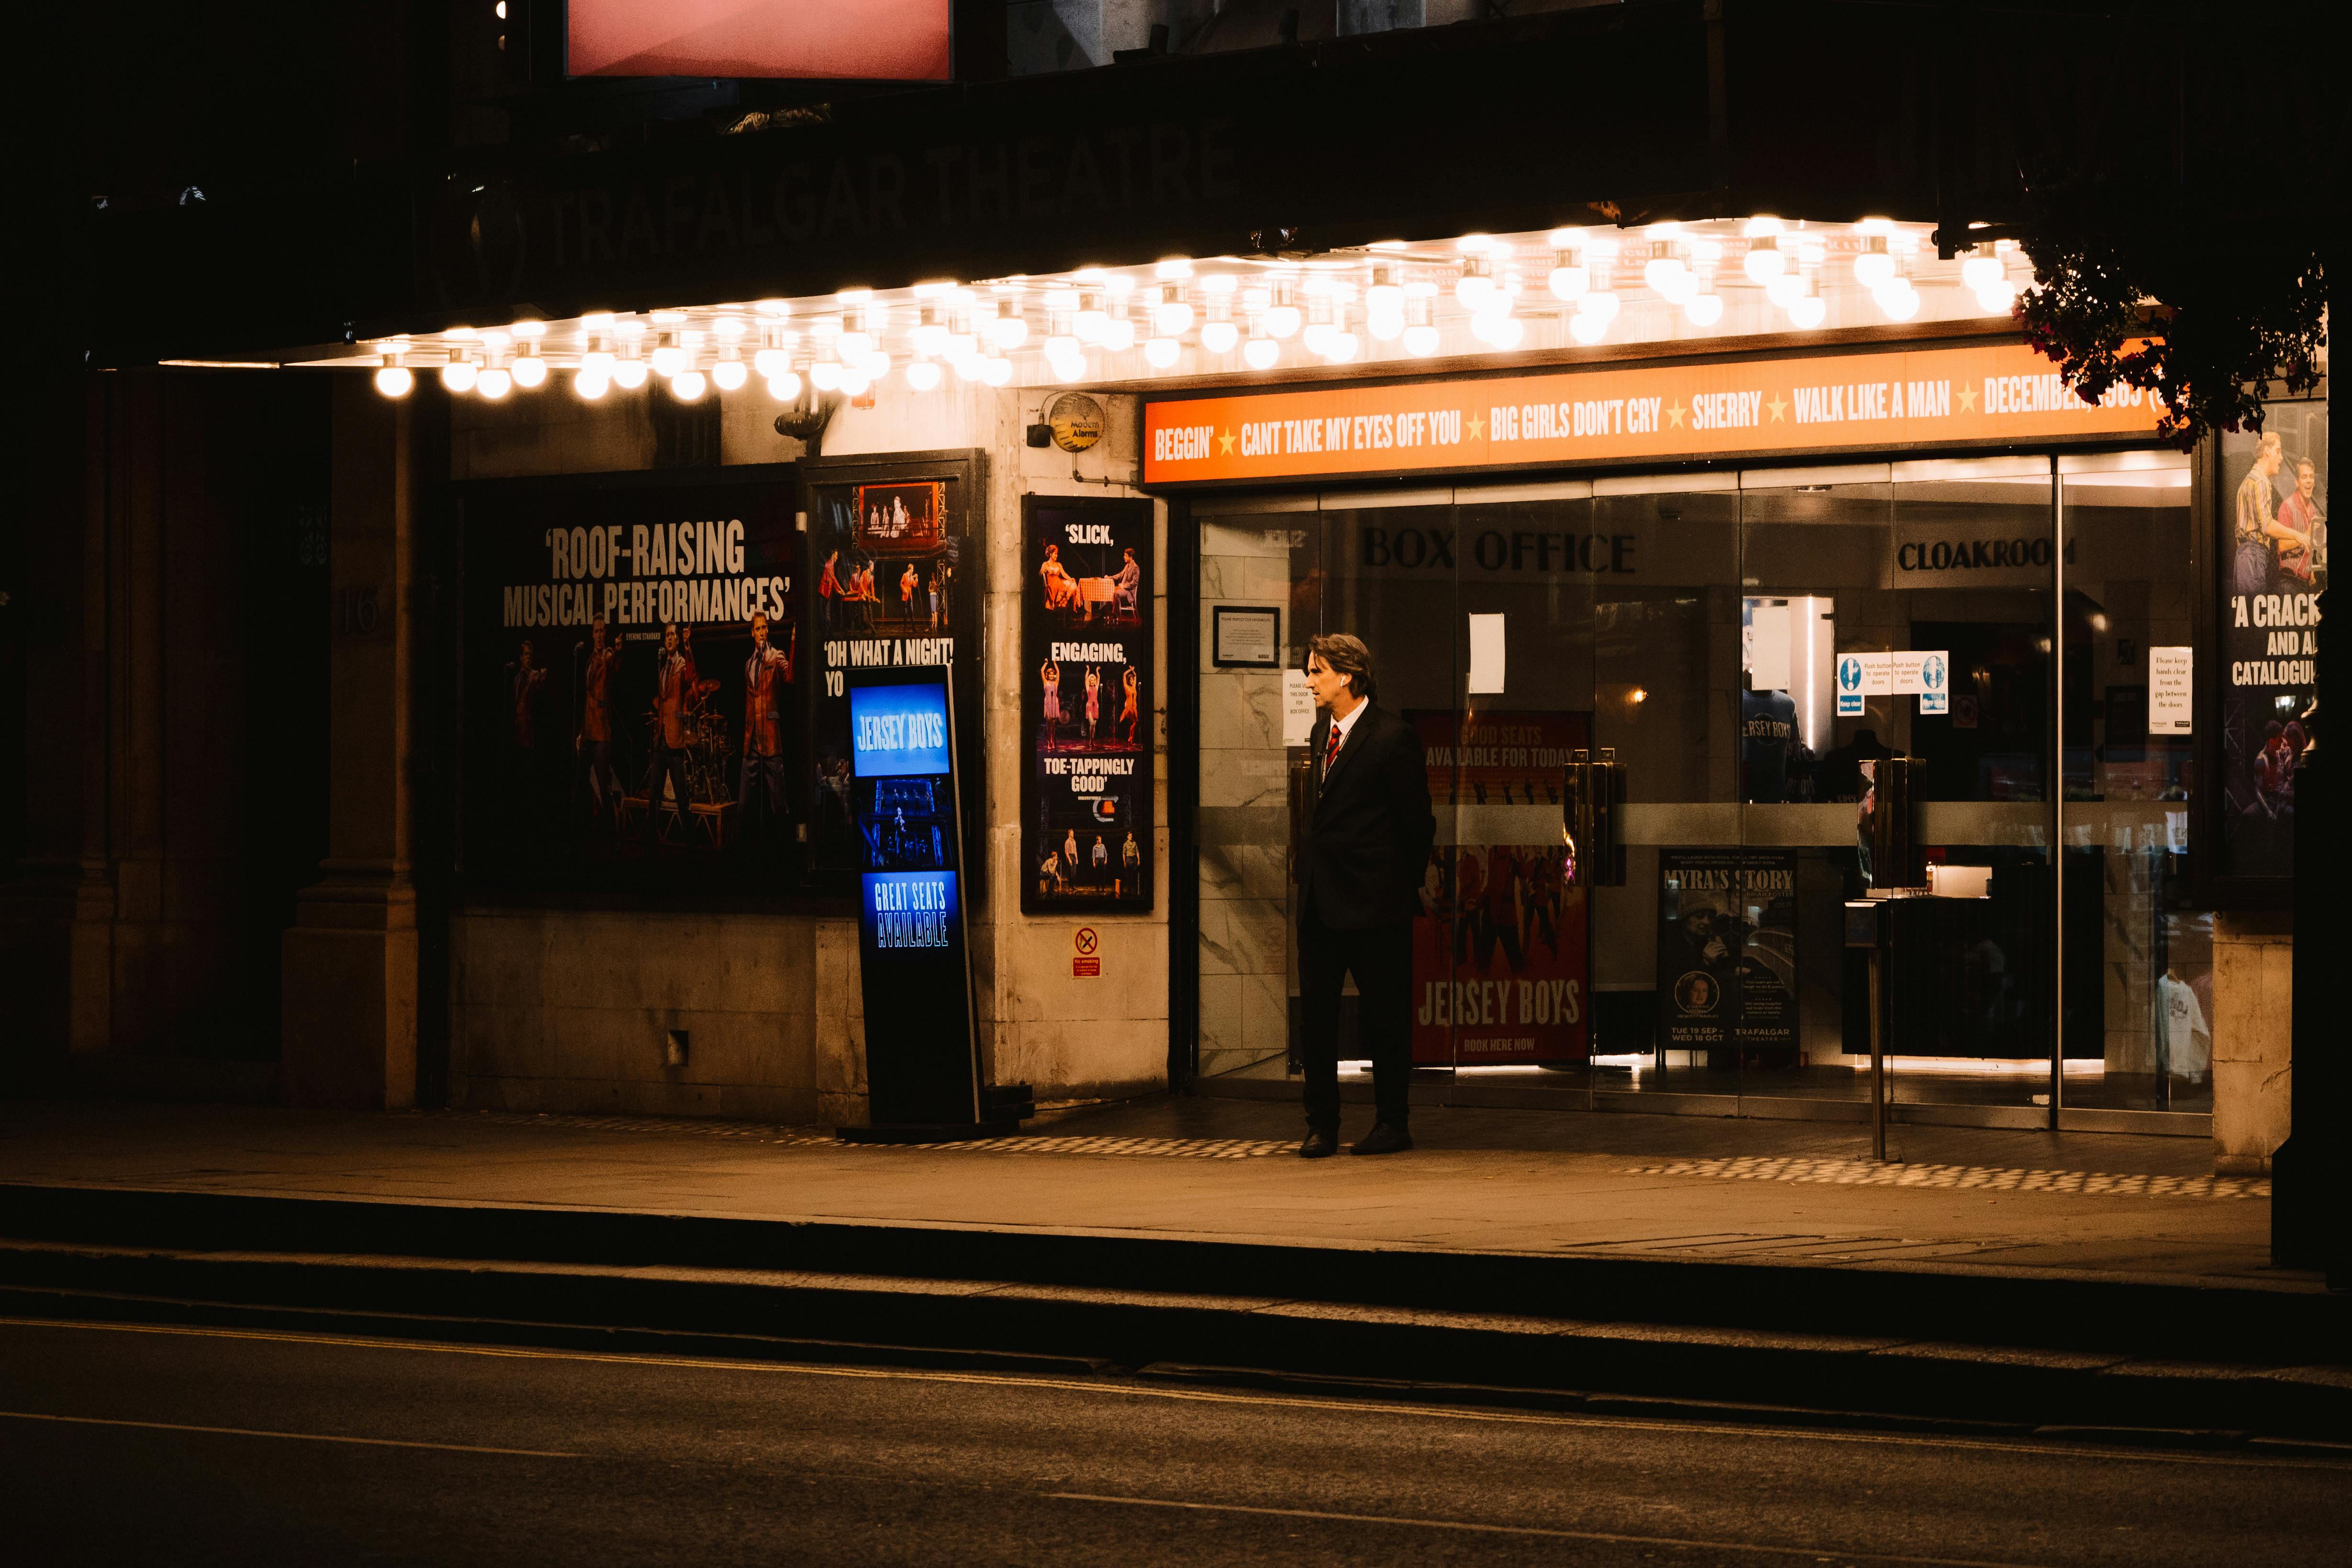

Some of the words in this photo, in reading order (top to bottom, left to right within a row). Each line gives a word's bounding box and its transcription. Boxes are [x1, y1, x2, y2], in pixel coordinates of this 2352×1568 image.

[547, 152, 907, 266] TRAFALGAR
[924, 115, 1240, 225] THEATRE
[1072, 429, 1098, 437] Alarms
[1155, 425, 1214, 461] BEGGIN'
[1242, 421, 1281, 456] CANT
[1284, 419, 1322, 453] TAKE
[1326, 417, 1351, 451] MY
[1354, 414, 1393, 449] EYES
[1396, 412, 1425, 448] OFF
[1428, 410, 1461, 445] YOU
[1490, 405, 1518, 441] BIG
[1522, 403, 1570, 440] GIRLS
[1573, 399, 1624, 437] DON'T
[1627, 397, 1662, 434] CRY
[1692, 390, 1762, 430] SHERRY
[1793, 385, 1844, 424] WALK
[1848, 382, 1888, 420] LIKE
[1891, 382, 1904, 418] A
[1907, 380, 1950, 418] MAN
[1065, 524, 1114, 547] 'SLICK,
[546, 519, 745, 579] 'ROOF-RAISING
[1364, 527, 1455, 570] BOX
[1475, 531, 1636, 574] OFFICE
[342, 582, 380, 635] 16
[503, 582, 594, 628] MUSICAL
[604, 576, 790, 624] PERFORMANCES'
[824, 640, 847, 667] 'OH
[850, 639, 891, 666] WHAT
[893, 639, 903, 665] A
[906, 638, 953, 665] NIGHT!
[1051, 642, 1127, 664] ENGAGING,
[2267, 631, 2299, 656] AND
[2175, 657, 2187, 666] keep
[857, 715, 905, 751] JERSEY
[908, 713, 943, 749] BOYS
[1501, 725, 1542, 745] SEATS
[1742, 720, 1770, 737] ERSEY
[1044, 758, 1135, 775] TOE-TAPPINGLY
[1425, 747, 1498, 767] AVALABLE
[1502, 747, 1528, 767] FOR
[1531, 747, 1574, 767] TODAY
[1071, 775, 1108, 792] GOOD'
[1664, 869, 1729, 890] MYRA'S
[874, 882, 907, 911] GREAT
[912, 881, 945, 911] SEATS
[877, 911, 949, 948] AVAILABLE
[1418, 980, 1511, 1027] JERSEY
[1518, 979, 1579, 1025] BOYS
[1464, 1038, 1488, 1053] BOOK
[1490, 1038, 1512, 1052] HERE
[1514, 1038, 1535, 1052] NOW
